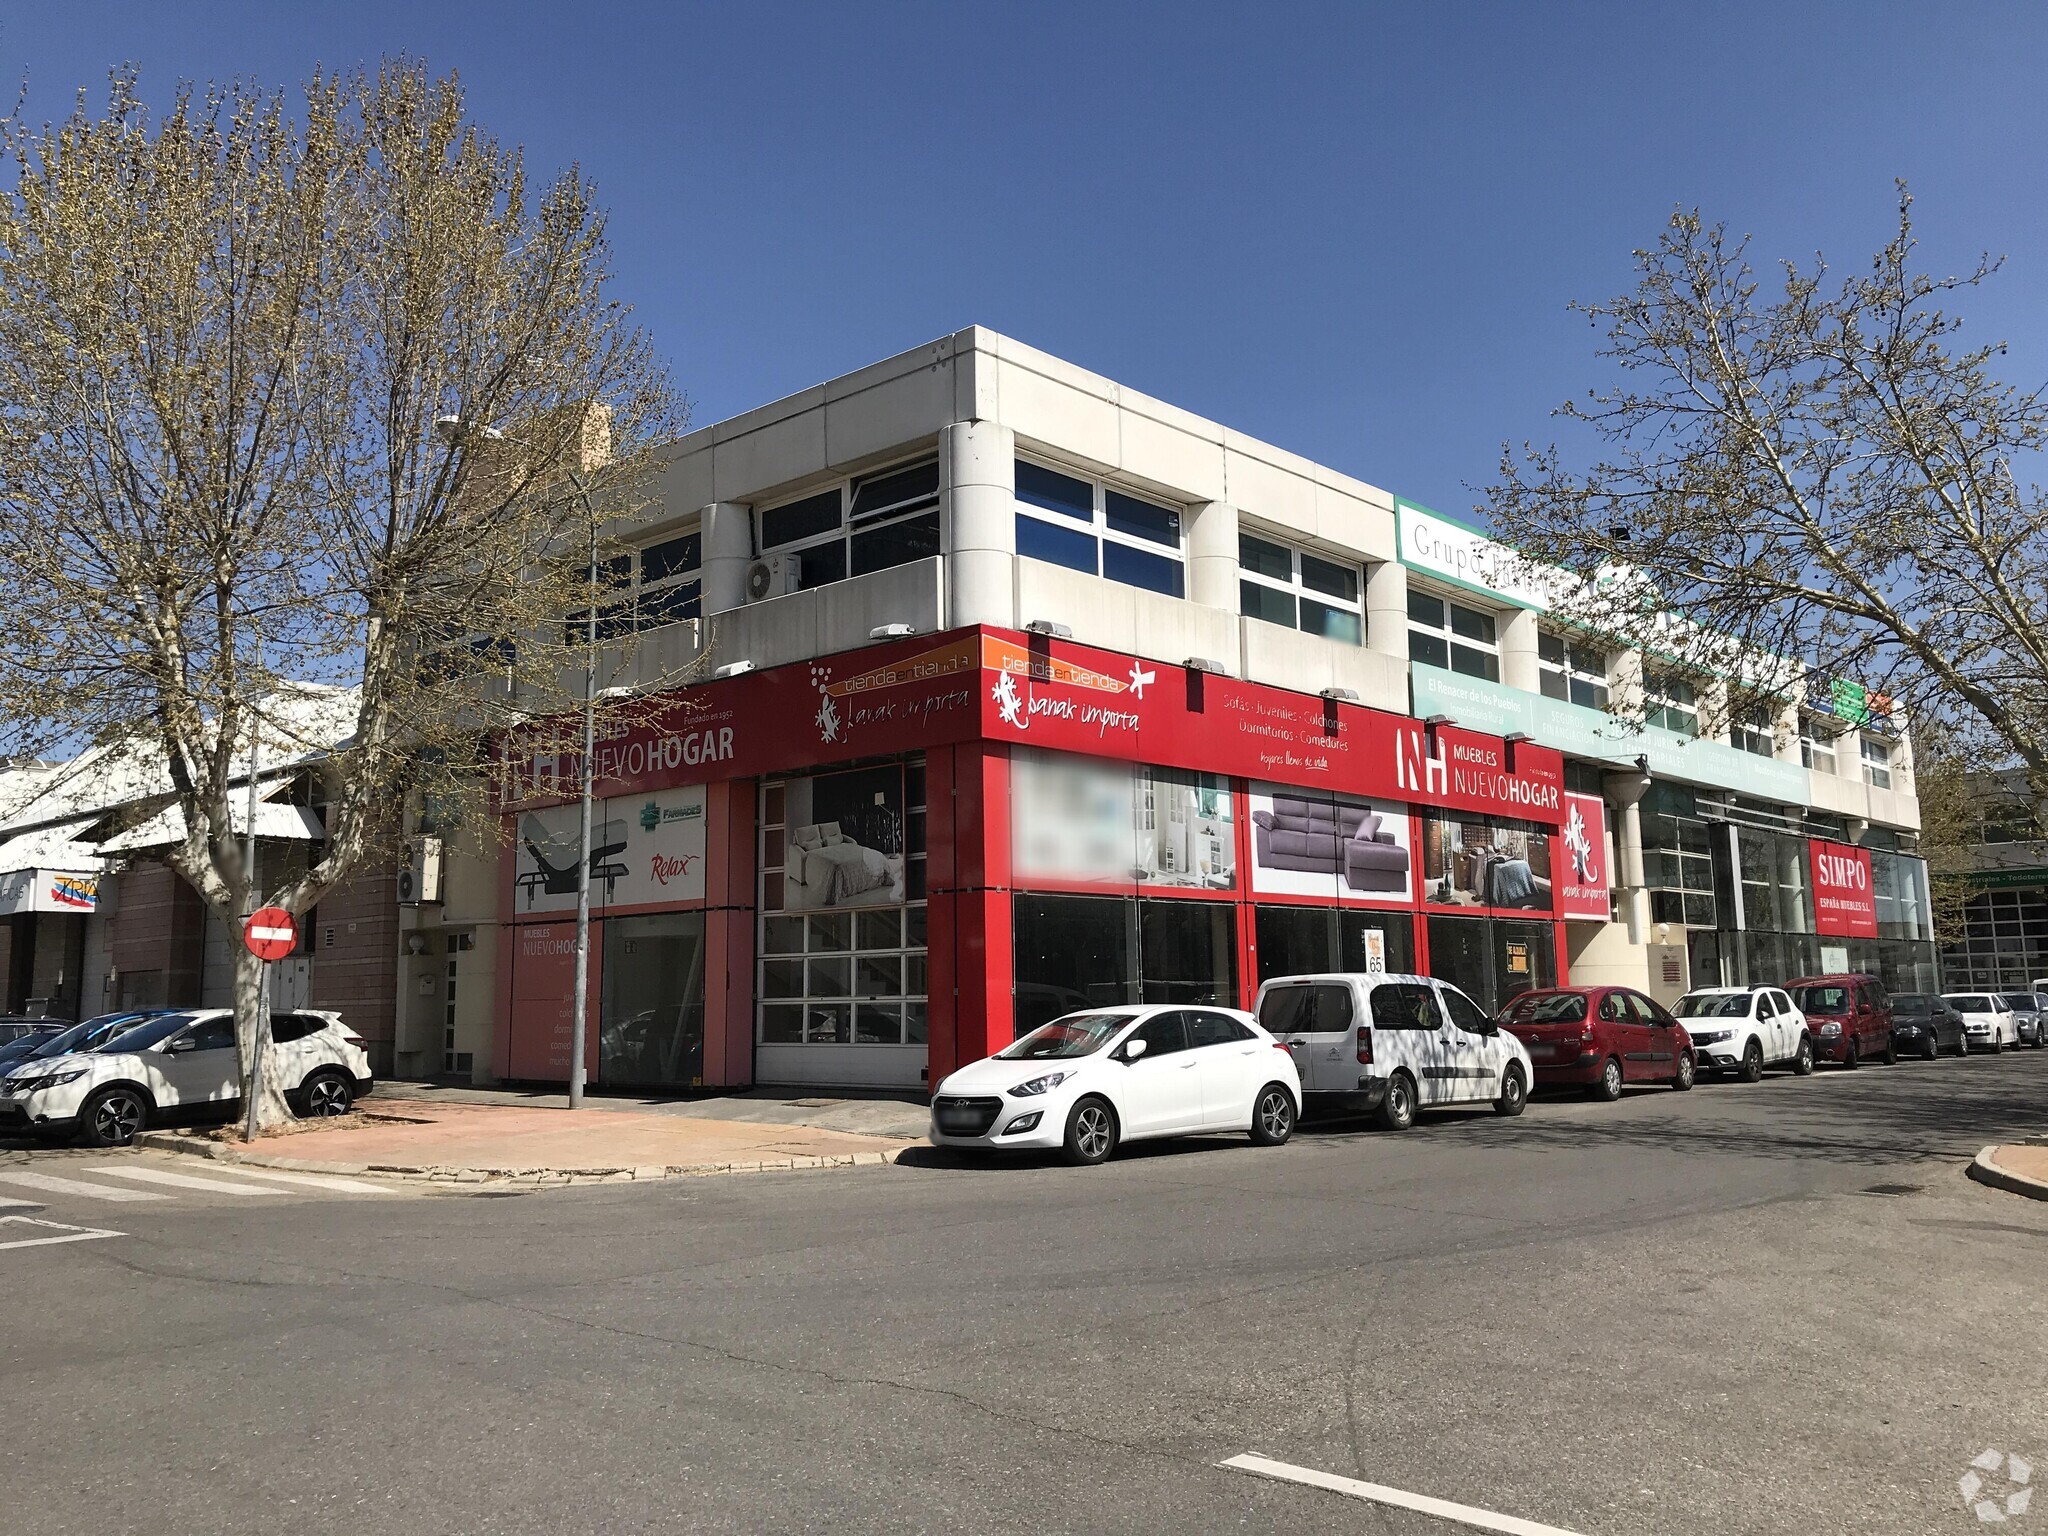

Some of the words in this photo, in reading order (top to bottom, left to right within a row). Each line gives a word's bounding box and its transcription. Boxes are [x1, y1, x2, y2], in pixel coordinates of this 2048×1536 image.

[1414, 524, 1481, 579] Grupo
[1002, 654, 1119, 691] tiendaentienda
[1428, 678, 1436, 692] El
[1437, 680, 1468, 700] Renacer
[1470, 688, 1480, 702] de
[1481, 690, 1492, 706] los
[1493, 694, 1522, 713] Pueblos
[683, 713, 710, 725] Fundado
[710, 713, 719, 721] en
[719, 710, 734, 720] 1952
[1028, 682, 1077, 720] banak
[1081, 703, 1140, 739] importa
[1223, 694, 1250, 712] Sofás
[1256, 701, 1297, 721] Juveniles
[1304, 711, 1348, 732] Colchones
[1488, 712, 1504, 725] Rural
[1551, 710, 1585, 729] SEGUROS
[1240, 718, 1294, 741] Dormitorios
[1300, 730, 1349, 751] Comedores
[1260, 751, 1284, 771] hogares
[1305, 755, 1313, 767] de
[1314, 756, 1328, 768] vida
[1453, 743, 1498, 767] MUEBLES
[1455, 767, 1559, 810] NUEVOHOGAR
[651, 853, 690, 885] Relax
[1819, 853, 1866, 891] SIMPO
[1820, 896, 1840, 910] ESPAÑA
[1840, 899, 1861, 912] MUEBLES
[523, 928, 550, 939] MUEBLES
[523, 939, 591, 956] NUEVOHOGR
[1370, 956, 1382, 973] 65
